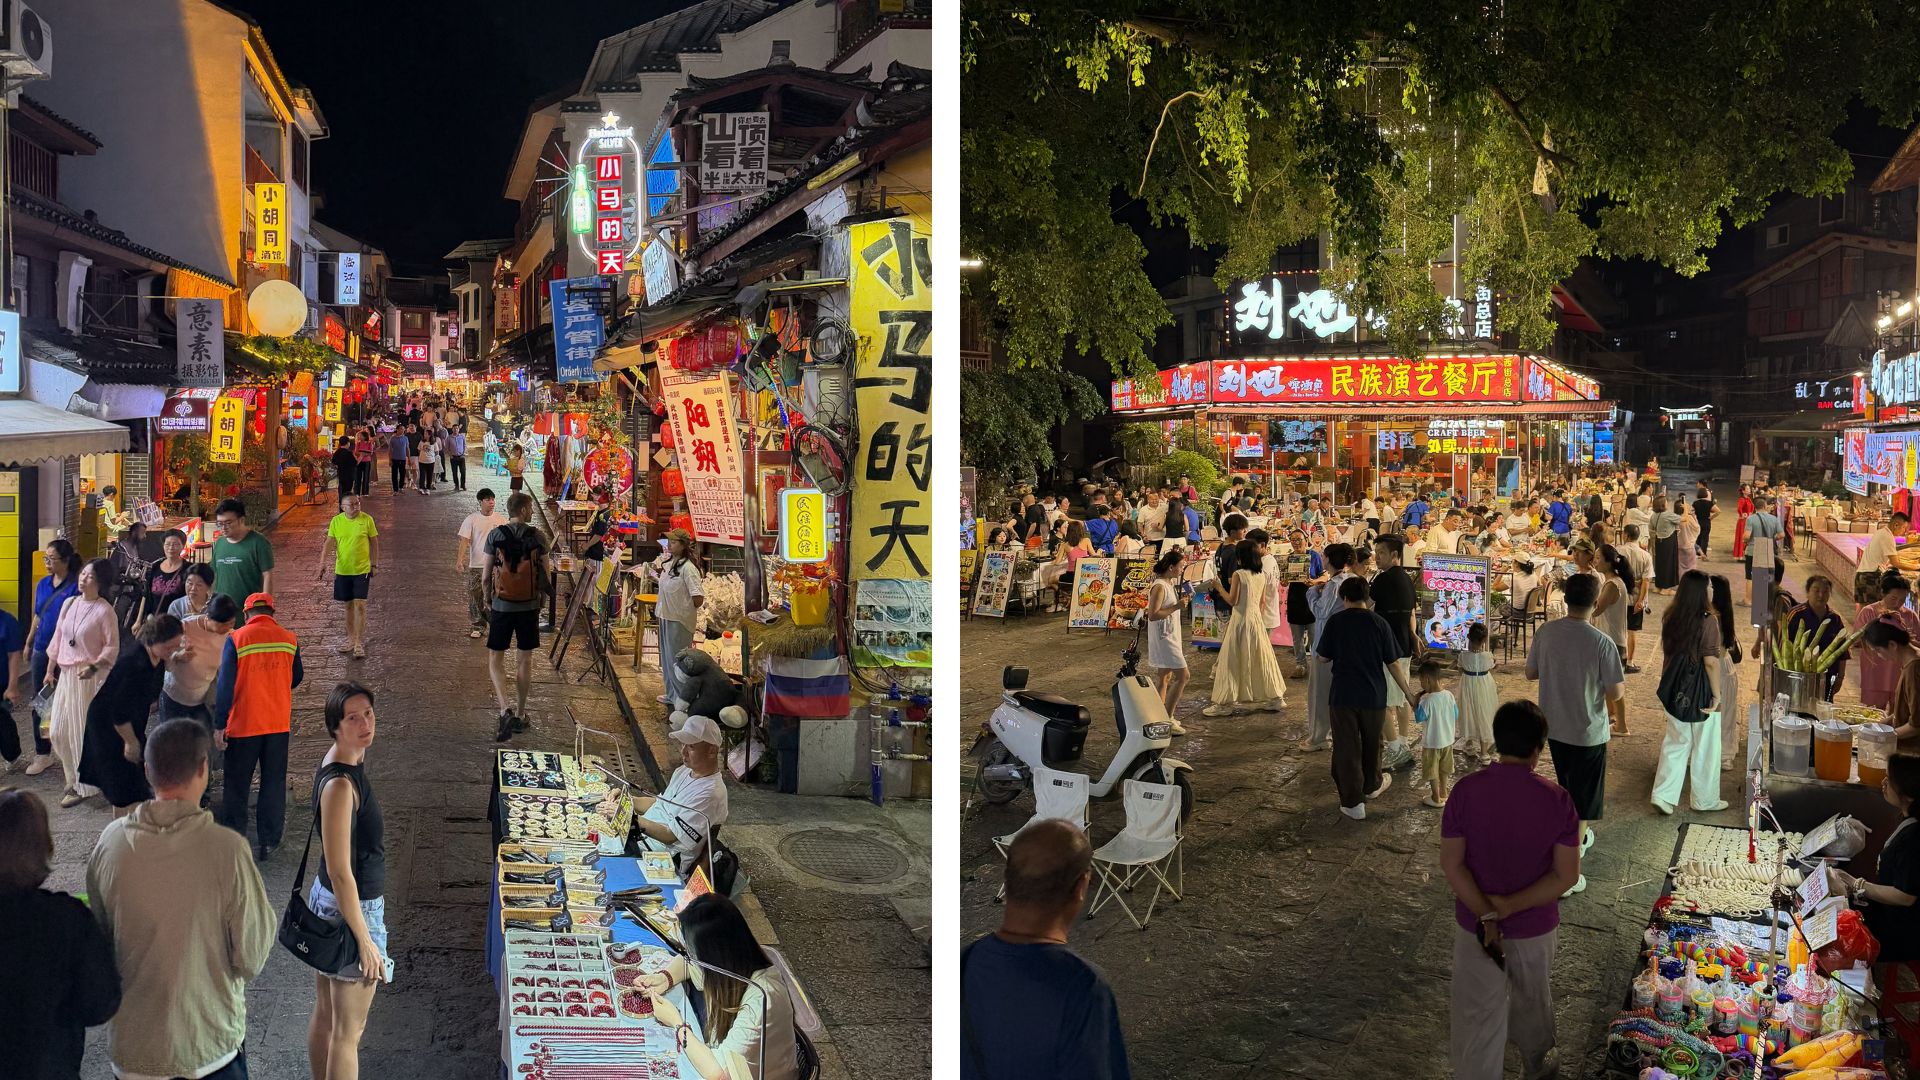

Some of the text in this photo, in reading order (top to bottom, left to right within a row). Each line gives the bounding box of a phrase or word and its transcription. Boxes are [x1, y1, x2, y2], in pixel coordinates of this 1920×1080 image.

[598, 137, 623, 149] SILVER
[703, 142, 765, 169] 看看
[262, 186, 279, 247] 小胡同
[600, 158, 623, 273] 小马的天
[261, 250, 282, 260] 酒馆
[342, 256, 356, 295] 临江仙
[500, 292, 512, 328] 土特产批发
[1474, 280, 1492, 338] 街总店
[186, 301, 213, 363] 意素
[403, 346, 426, 359] 旗袍
[181, 363, 220, 378] 摄影馆
[560, 365, 582, 378] Orderly
[1218, 363, 1286, 398] 刘姐
[1330, 360, 1498, 397] 民族演艺餐厅
[1503, 358, 1512, 398] 西街总店
[855, 221, 932, 577] 小马的天
[1794, 381, 1830, 398] 乱了
[219, 400, 236, 450] 小胡同
[681, 397, 721, 475] 阳朔
[1427, 429, 1486, 437] CRAFT BEER
[215, 451, 236, 460] 酒馆
[1427, 438, 1457, 454] 外卖
[296, 941, 309, 954] alo
